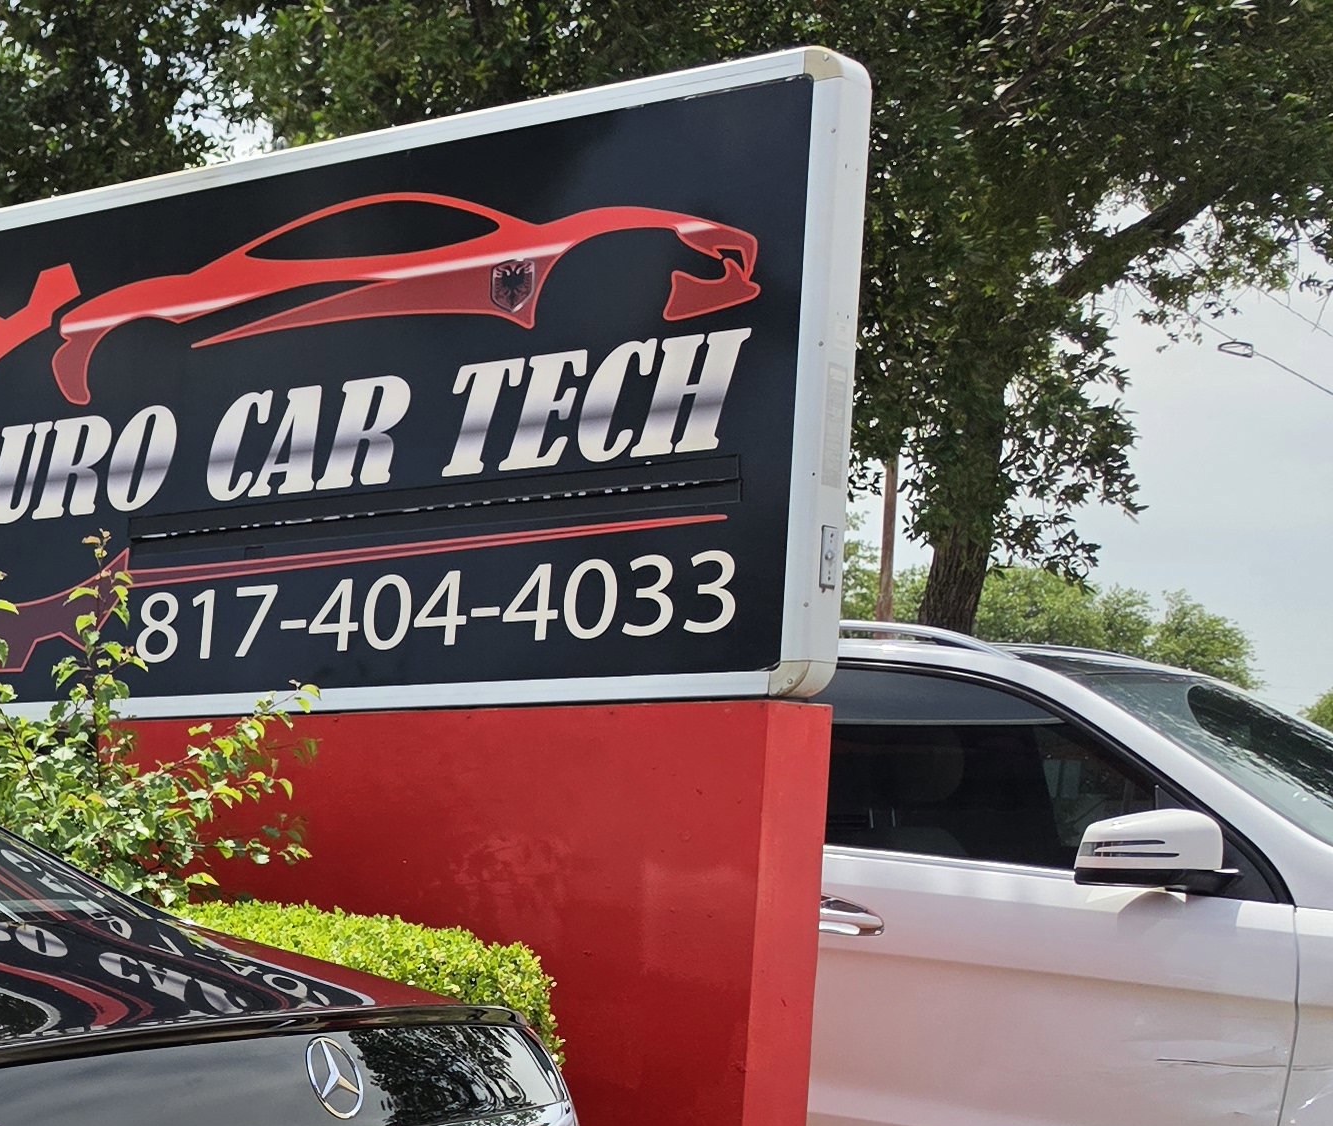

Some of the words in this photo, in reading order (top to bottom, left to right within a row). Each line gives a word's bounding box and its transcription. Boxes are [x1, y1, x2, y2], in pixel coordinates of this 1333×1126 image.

[205, 374, 411, 502] CAR
[441, 327, 752, 478] TECH
[135, 549, 737, 664] 817-404-4033
